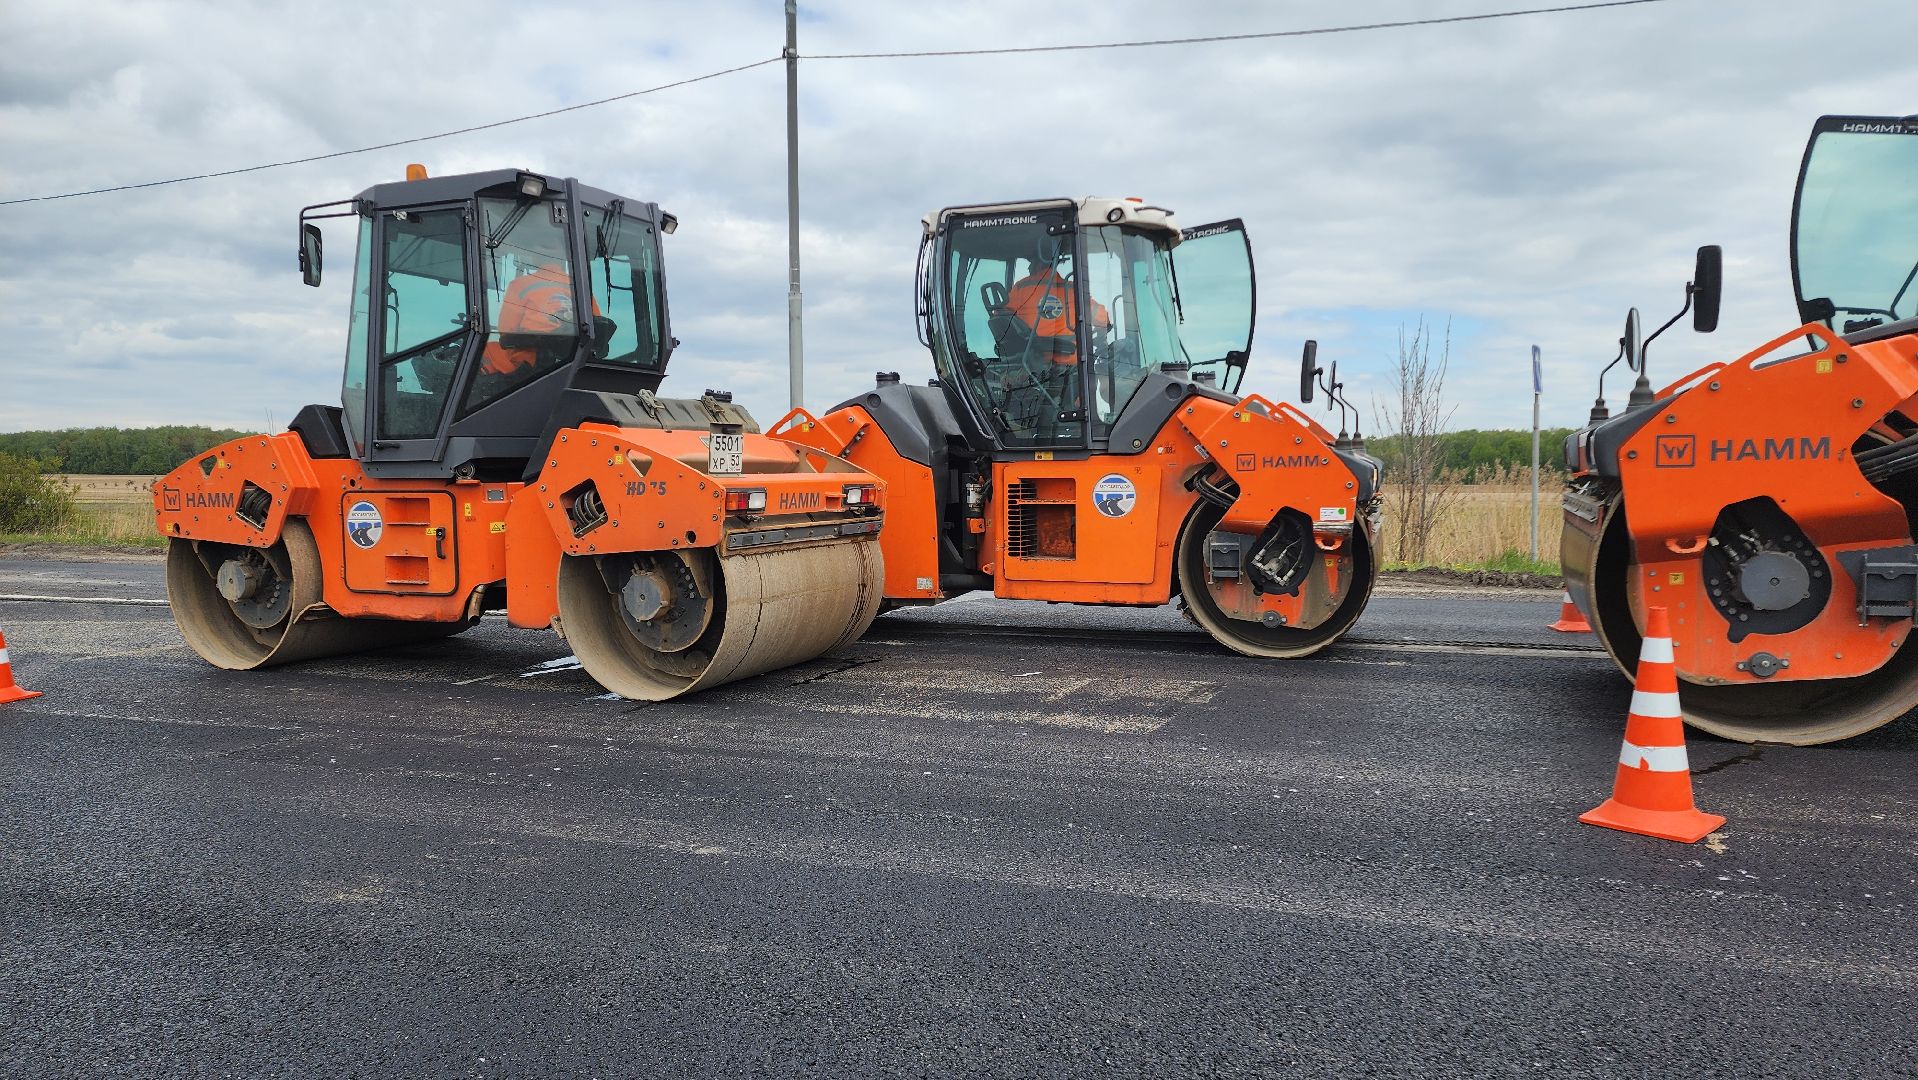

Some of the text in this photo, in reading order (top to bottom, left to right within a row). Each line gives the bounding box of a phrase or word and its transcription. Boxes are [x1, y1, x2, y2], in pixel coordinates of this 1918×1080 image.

[1842, 123, 1918, 133] HAMMT
[964, 215, 1037, 229] HAMMTRONIC
[715, 435, 739, 451] 5501
[1710, 437, 1832, 461] HAMM
[1262, 455, 1319, 468] HAMM
[626, 481, 646, 496] HD
[186, 492, 234, 508] HAMM
[780, 492, 820, 509] HAMM
